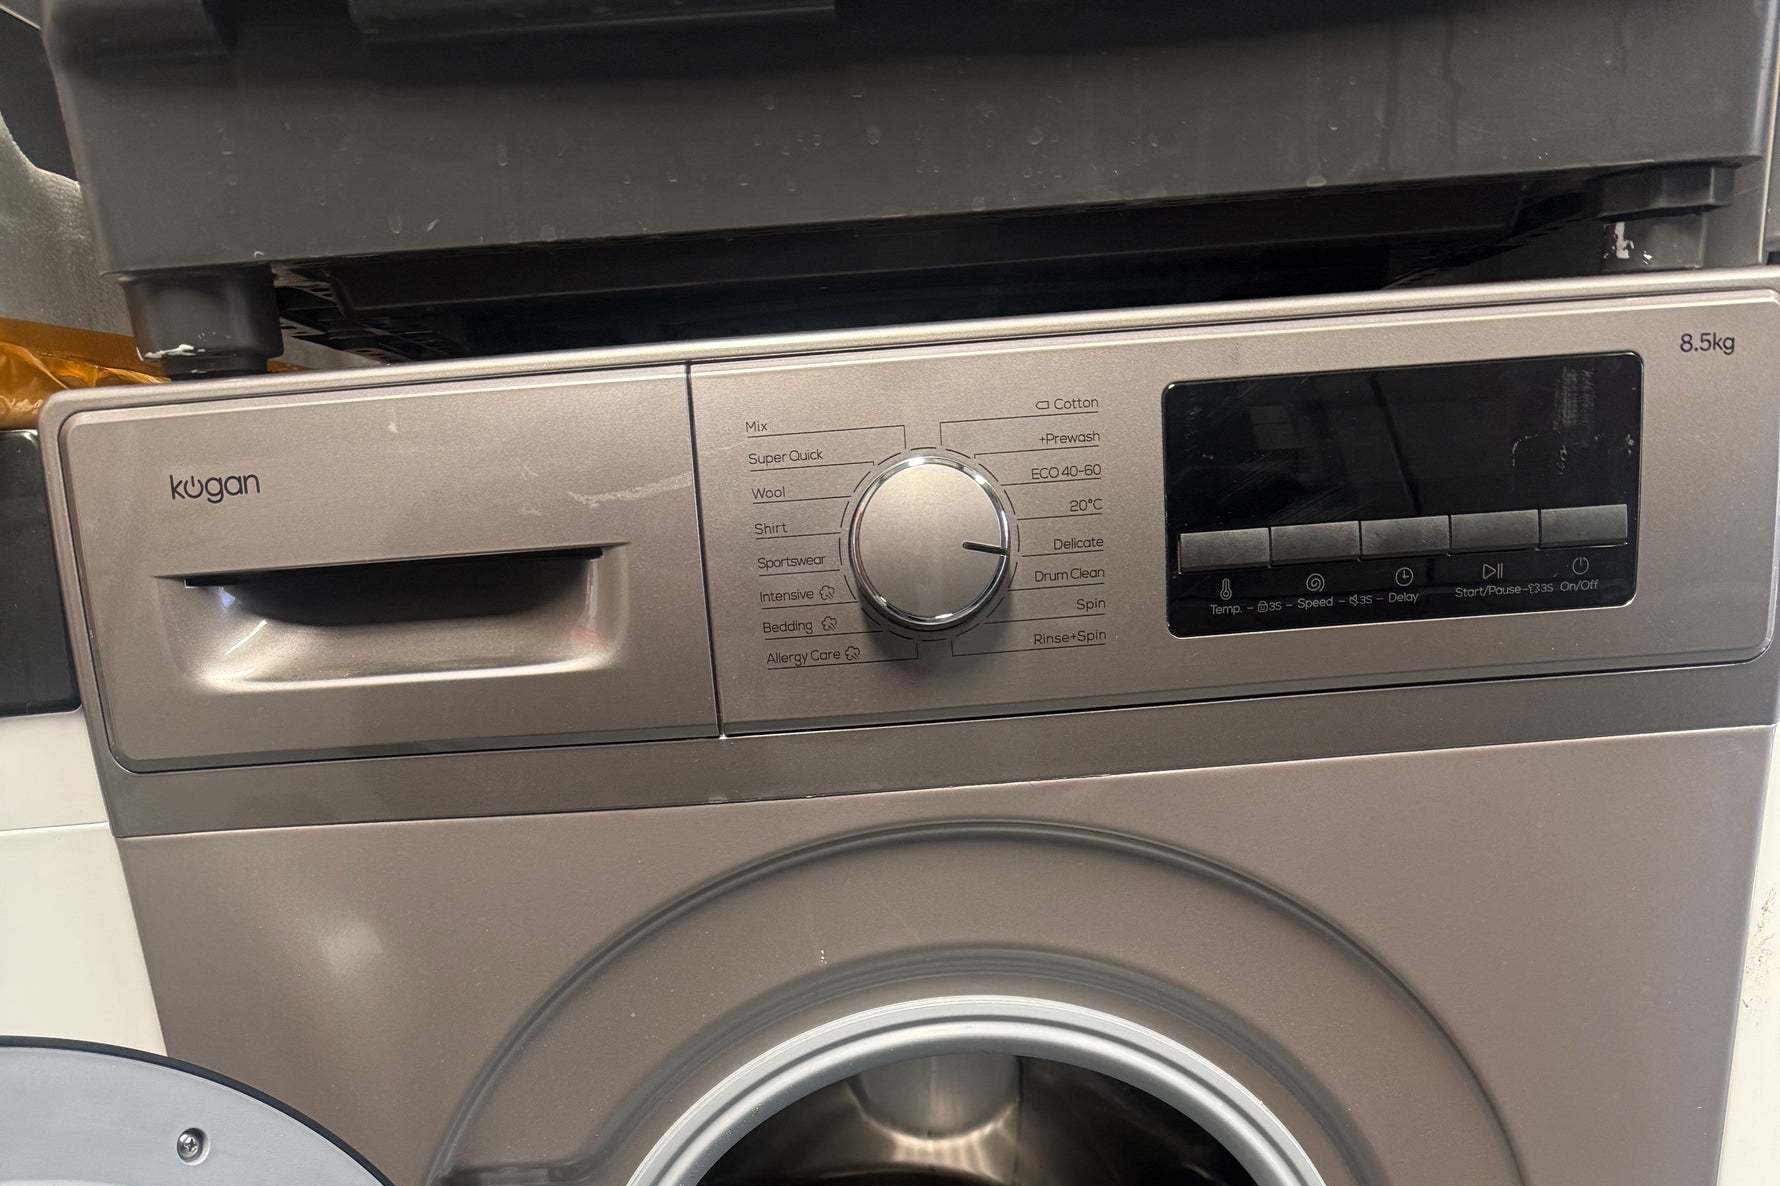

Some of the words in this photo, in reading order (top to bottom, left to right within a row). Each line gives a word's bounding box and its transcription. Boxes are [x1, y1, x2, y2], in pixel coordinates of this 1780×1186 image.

[1680, 332, 1735, 356] 8.5kg
[1053, 397, 1099, 411] Cotton
[745, 420, 768, 433] Mix
[1039, 431, 1101, 445] +Prewash
[748, 452, 788, 467] Super
[789, 449, 823, 463] Quick
[1031, 467, 1059, 480] ECO
[1060, 464, 1102, 478] 40-60
[169, 474, 261, 504] kogan
[751, 486, 785, 500] Wool
[1069, 498, 1103, 512] 20°C
[754, 522, 787, 535] Shirt
[1053, 536, 1104, 550] Delicate
[757, 554, 826, 572] Sportswear
[1034, 569, 1070, 583] Drum
[1071, 566, 1105, 580] Clean
[1559, 579, 1599, 592] On/Off
[759, 588, 814, 603] Intensive
[1076, 597, 1106, 613] Spin
[1210, 602, 1243, 616] Temp.
[1297, 596, 1334, 611] Speed
[1388, 591, 1419, 604] Delay
[762, 620, 813, 635] Bedding
[1034, 629, 1107, 646] Rinse+Spin
[766, 651, 811, 668] Allergy
[811, 648, 841, 662] Care
